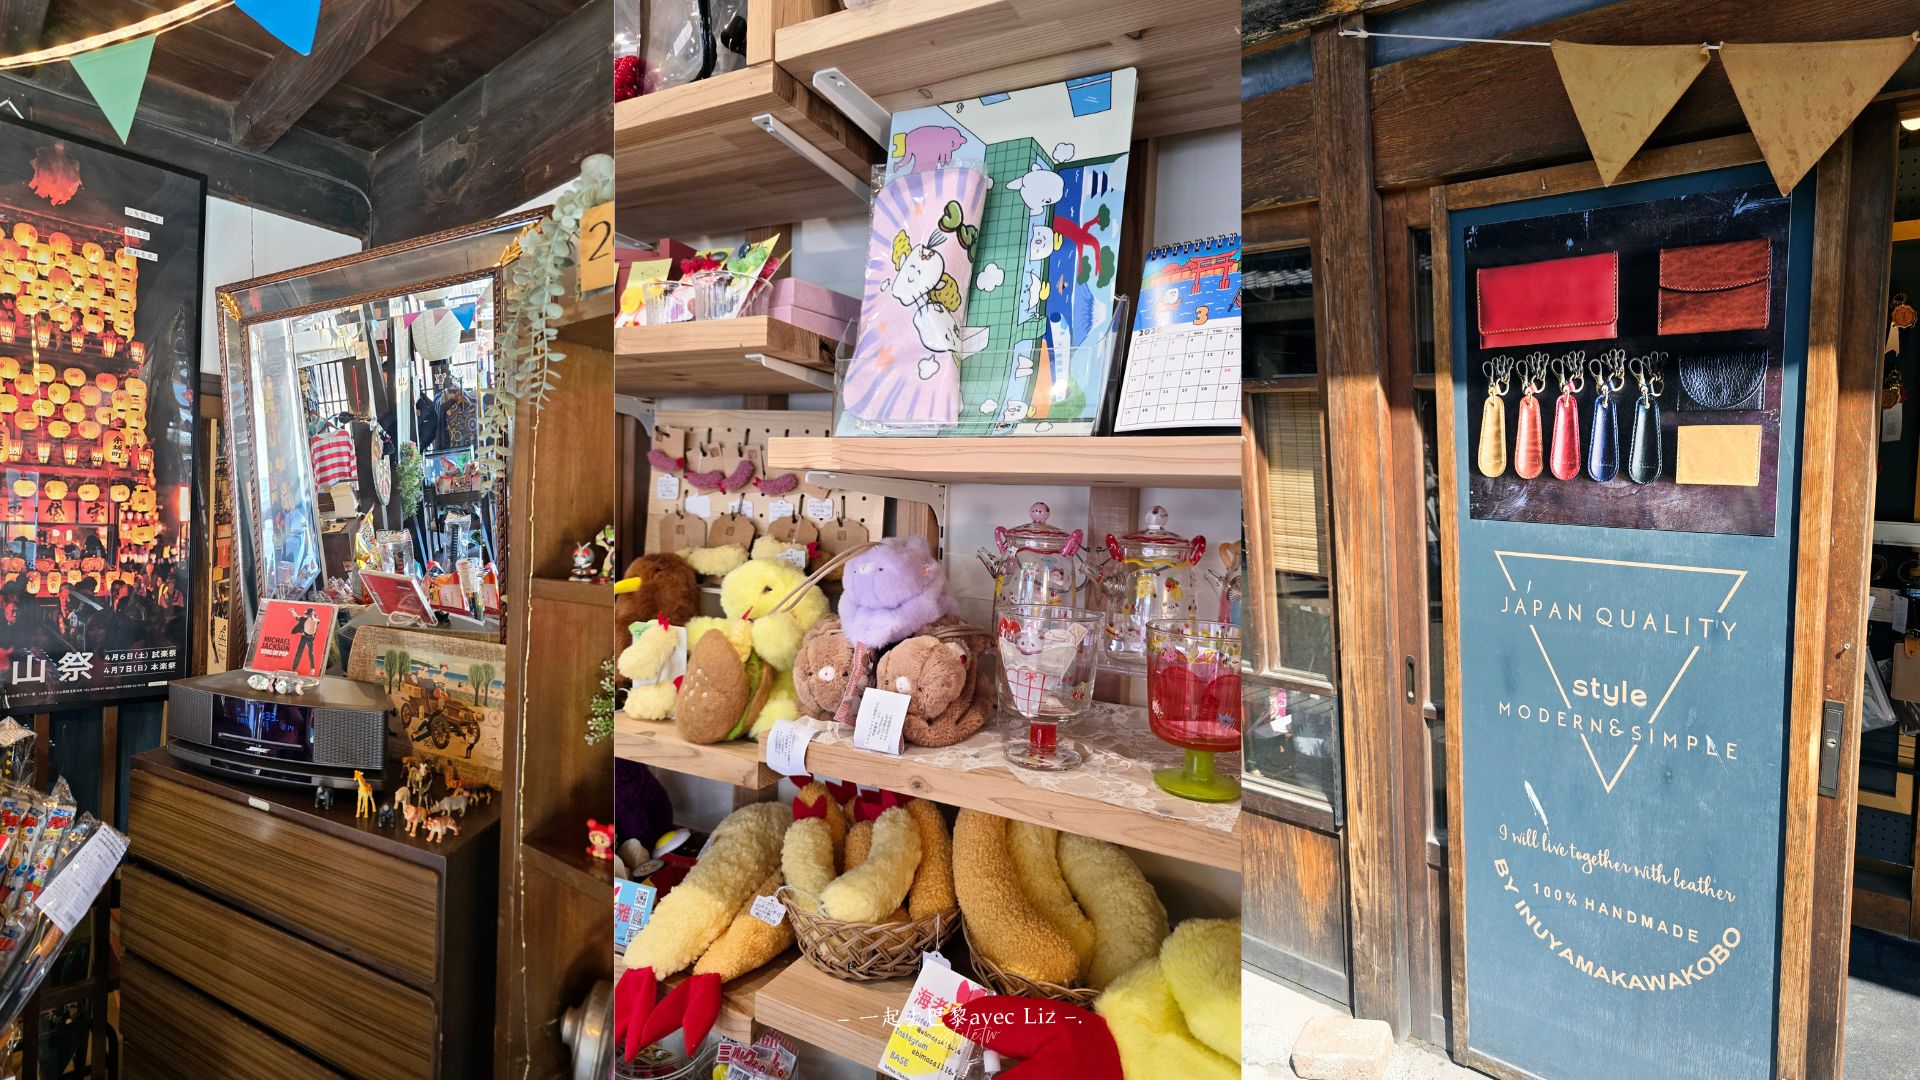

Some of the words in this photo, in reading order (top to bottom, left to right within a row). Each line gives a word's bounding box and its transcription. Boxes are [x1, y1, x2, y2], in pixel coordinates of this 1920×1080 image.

[1193, 306, 1210, 325] 3
[1501, 596, 1581, 622] JAPAN
[1596, 607, 1737, 640] QUALITY
[261, 642, 290, 652] JACKSON
[263, 636, 290, 645] MICHAEL
[151, 649, 177, 659] 試楽祭
[150, 662, 177, 671] 本楽祭
[1572, 678, 1647, 706] style
[1499, 824, 1508, 840] I
[1512, 828, 1539, 848] will
[1541, 832, 1568, 856] live
[1570, 843, 1632, 874] together
[1634, 864, 1671, 885] with
[1673, 868, 1736, 903] leather
[1532, 883, 1577, 906] 100%
[1585, 898, 1699, 943] HANDMADE
[1494, 859, 1520, 893] BY
[1514, 900, 1741, 991] INUYAMAKAWAKOBO
[895, 1028, 928, 1051] Instagram
[889, 1051, 910, 1067] BASE
